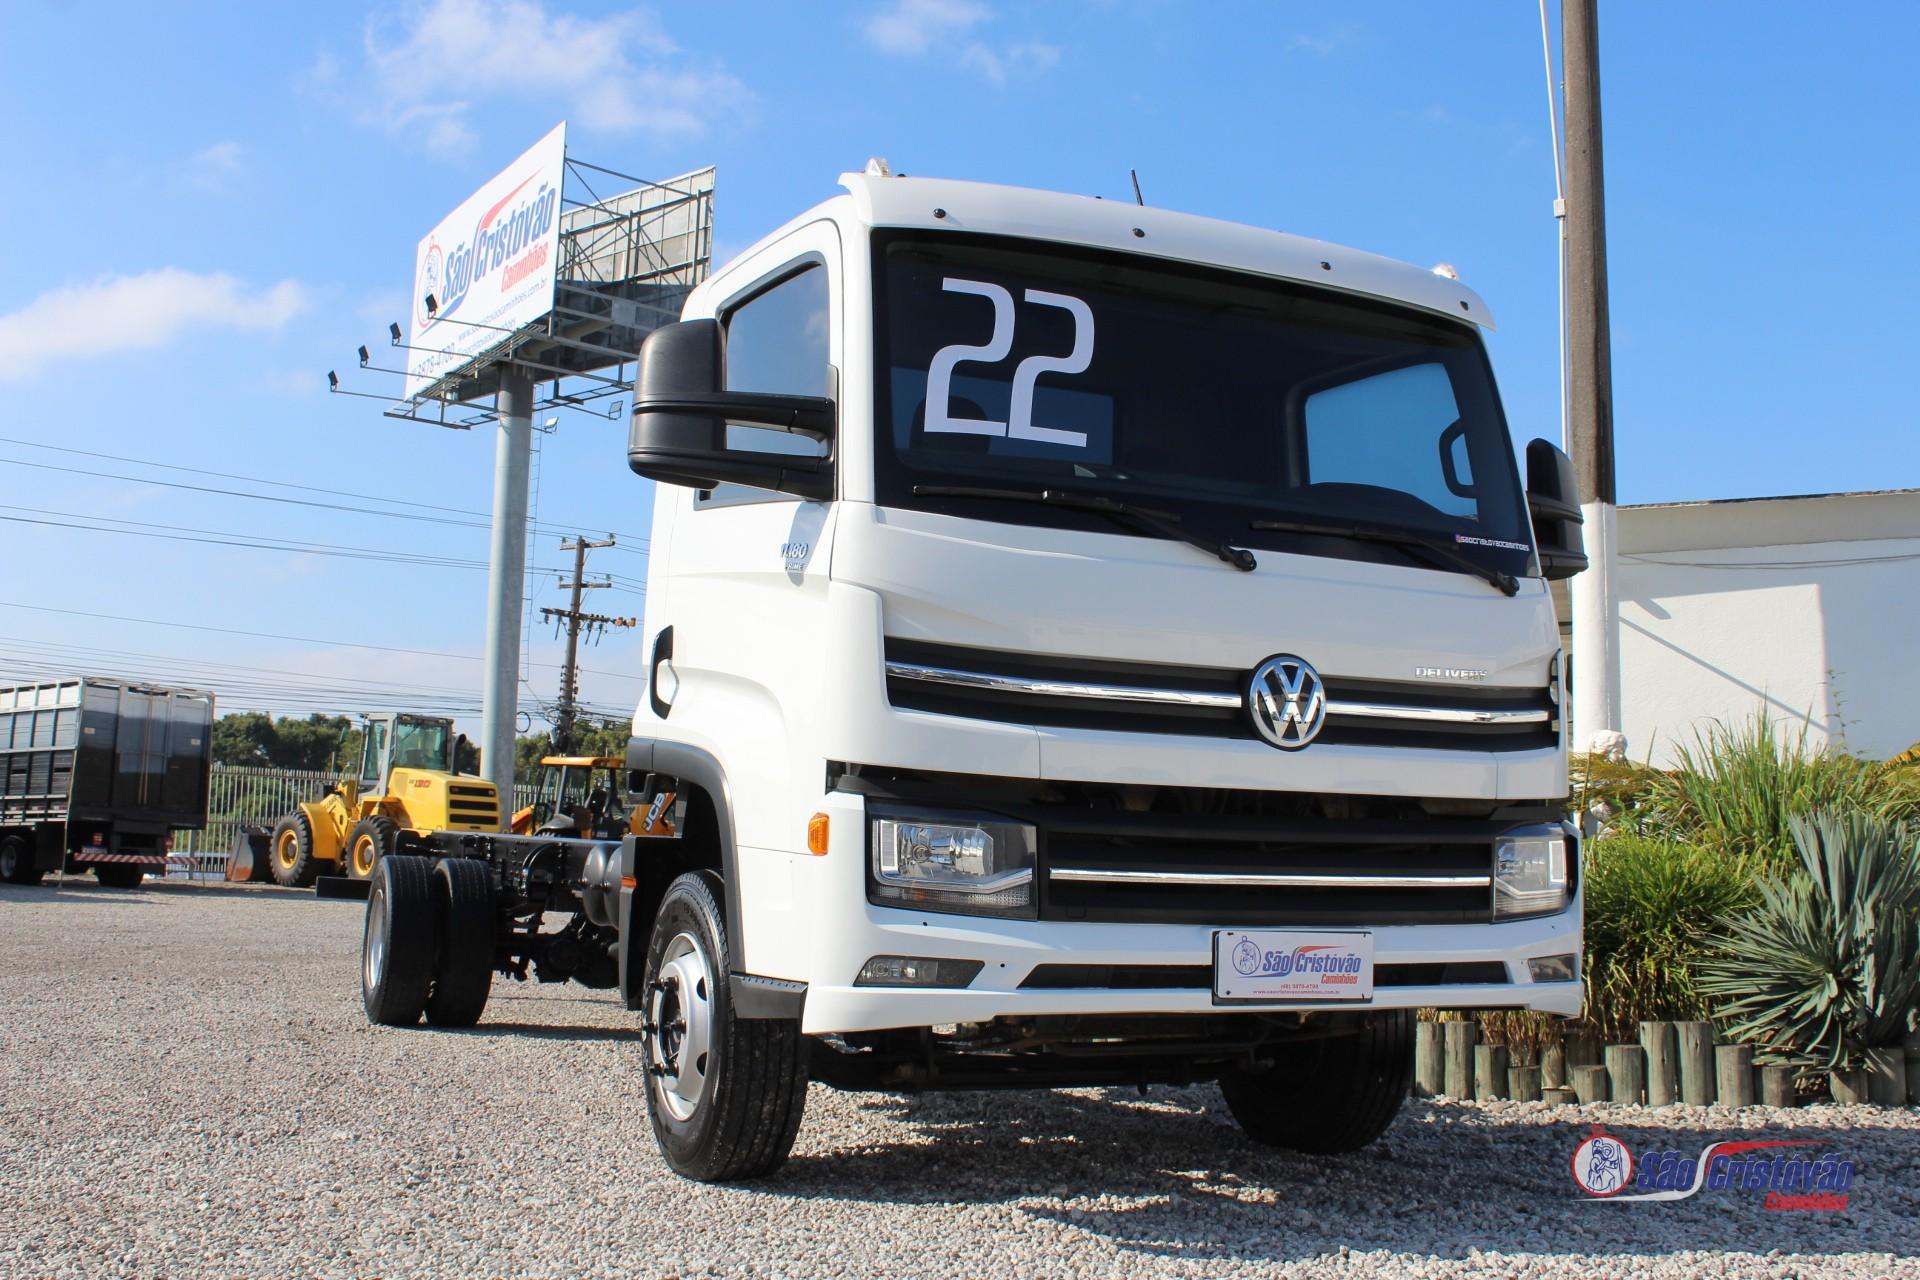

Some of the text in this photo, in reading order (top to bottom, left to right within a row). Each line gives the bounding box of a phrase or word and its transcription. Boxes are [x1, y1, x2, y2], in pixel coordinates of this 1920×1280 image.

[442, 181, 556, 306] São Cristóvão
[501, 241, 549, 293] Caminhões
[924, 277, 1095, 448] 22
[1415, 666, 1488, 682] DELIVERY
[641, 793, 666, 832] JCB
[1262, 951, 1362, 974] São Cristóvão
[1321, 973, 1358, 985] Caminhões
